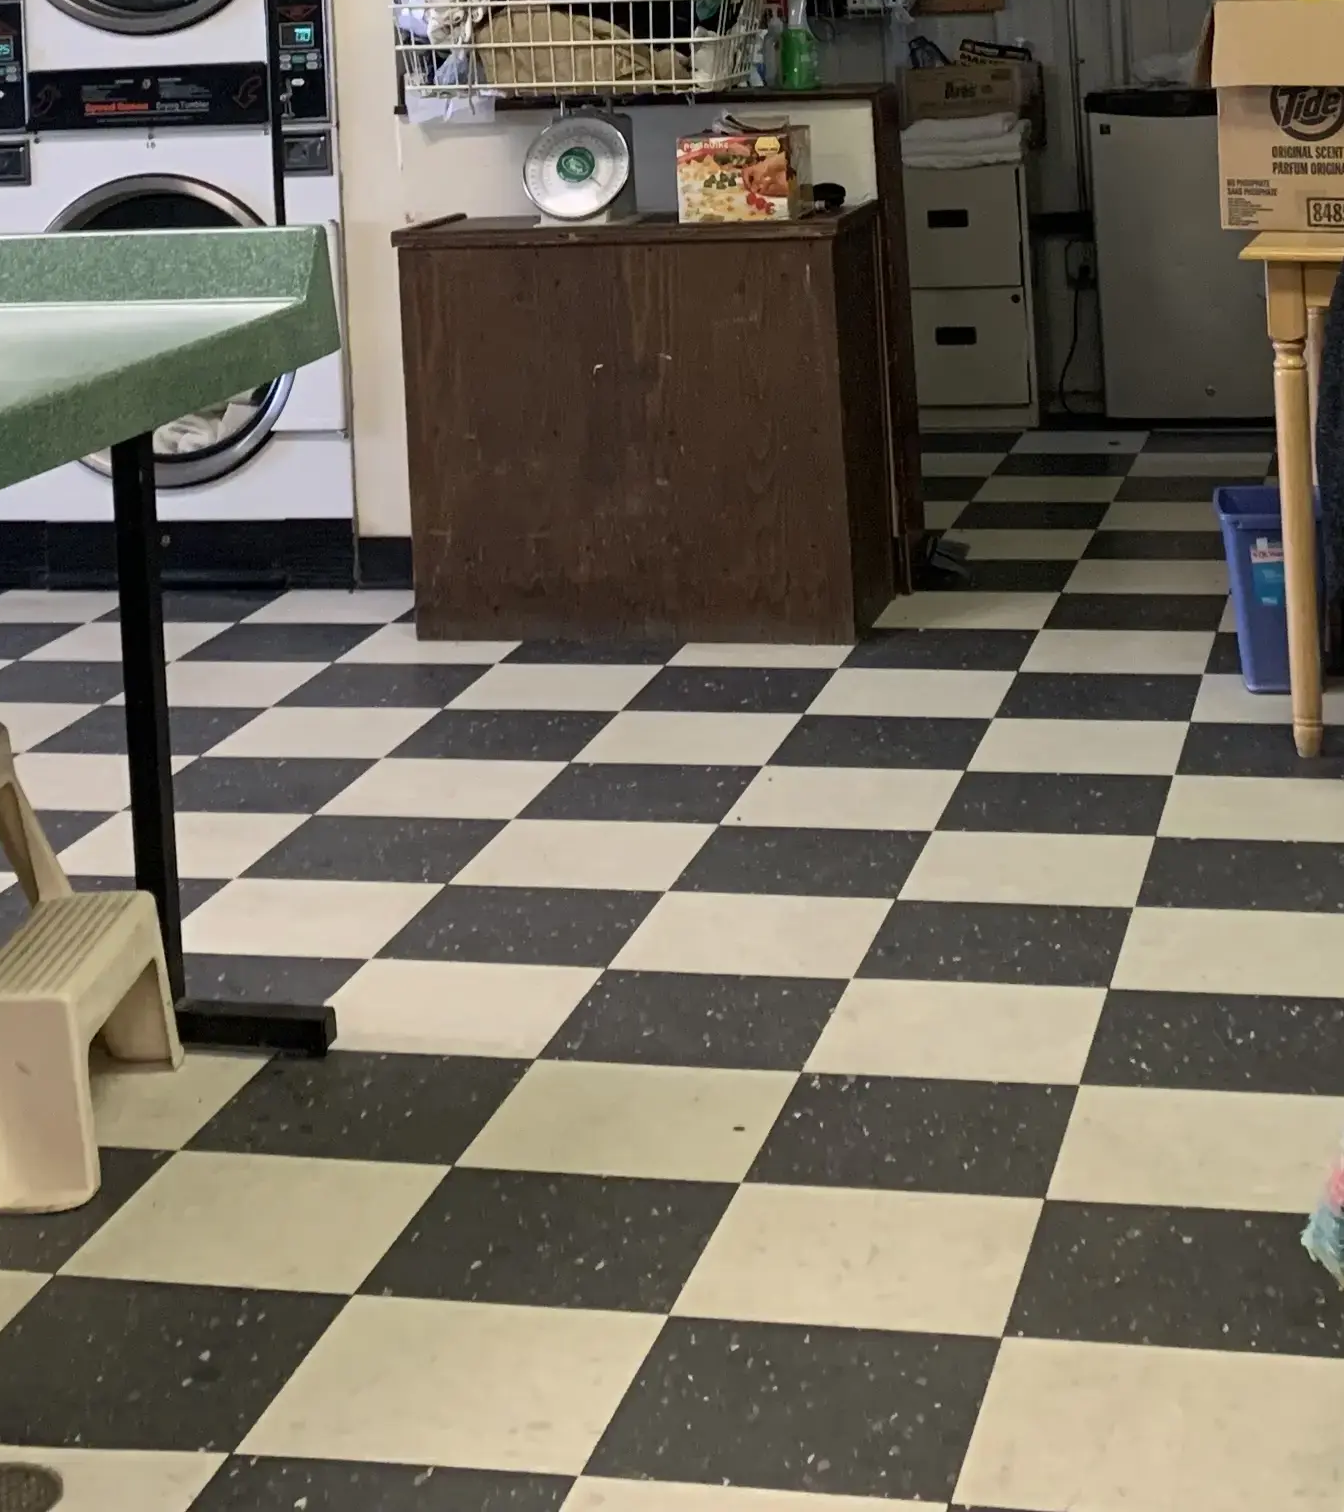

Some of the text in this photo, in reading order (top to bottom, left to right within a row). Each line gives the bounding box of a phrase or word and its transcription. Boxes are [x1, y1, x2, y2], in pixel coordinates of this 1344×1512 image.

[1277, 86, 1343, 128] Tide
[1271, 145, 1344, 160] ORIGINAL SCENT
[1272, 161, 1309, 175] PARFUM
